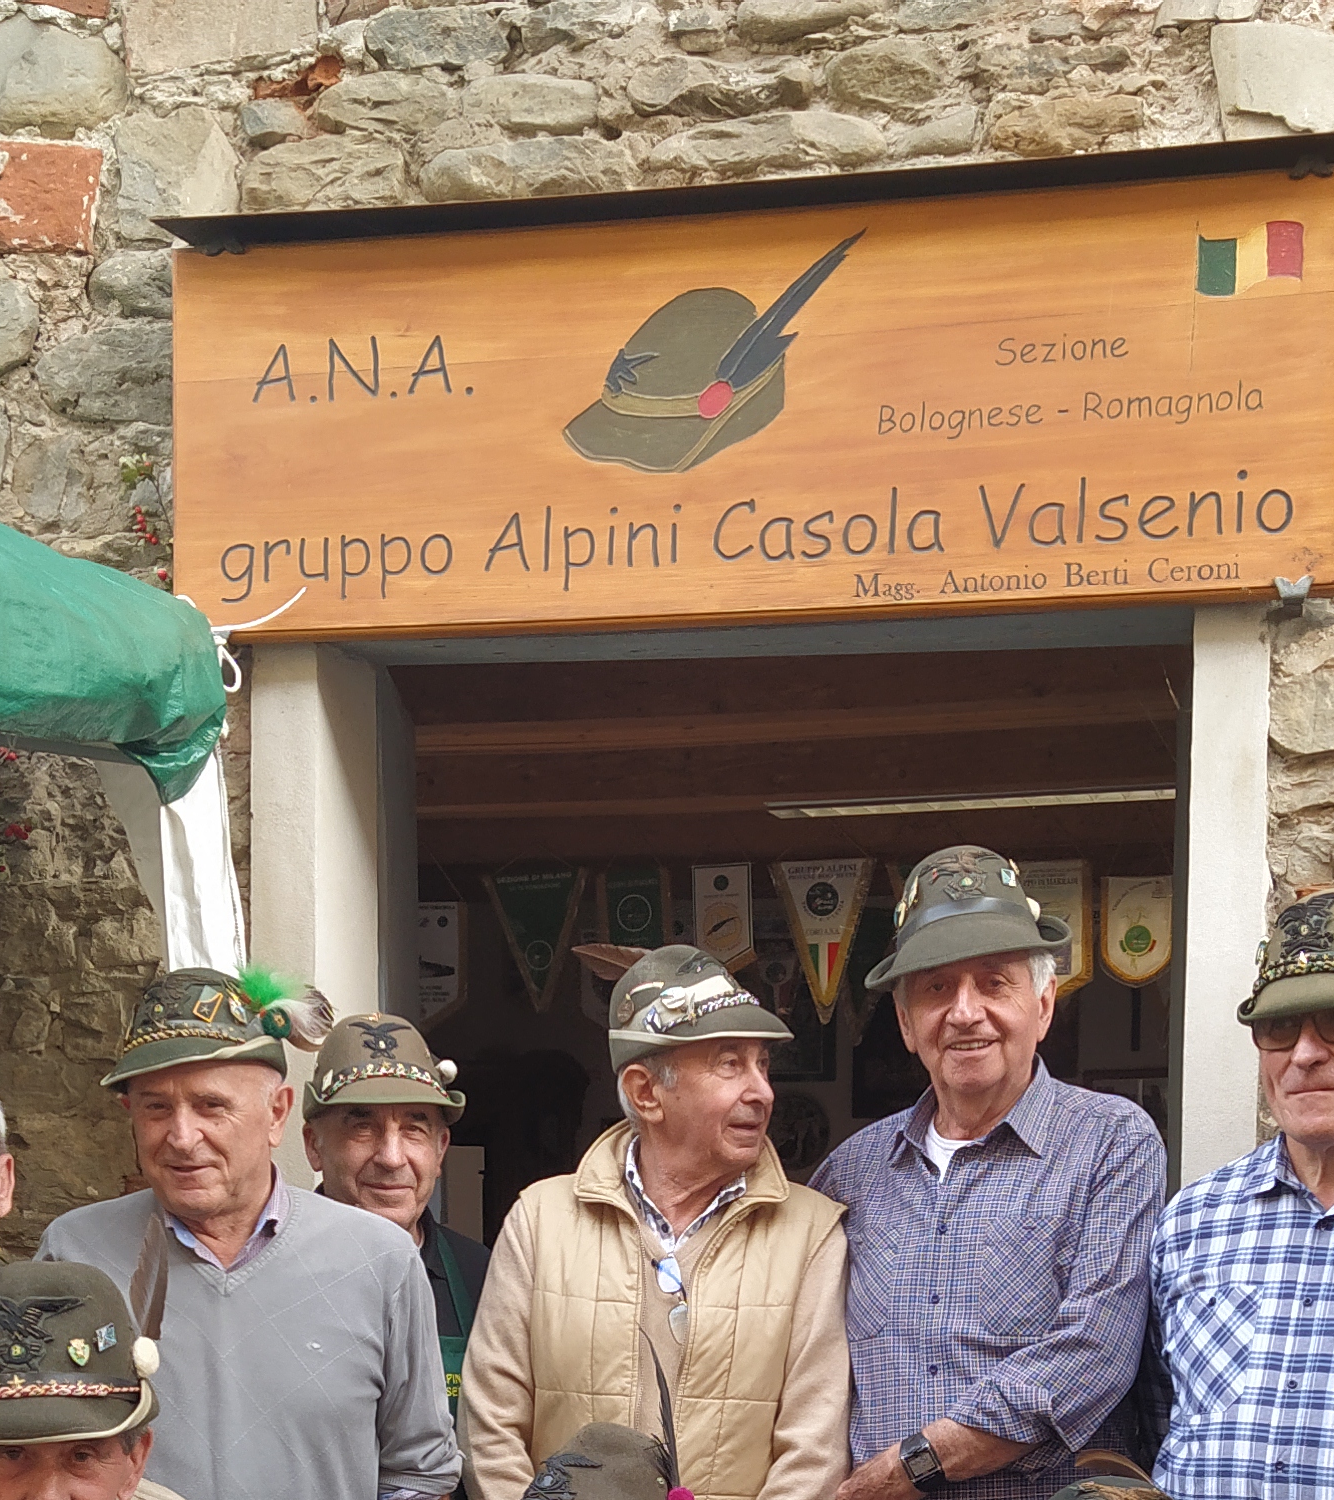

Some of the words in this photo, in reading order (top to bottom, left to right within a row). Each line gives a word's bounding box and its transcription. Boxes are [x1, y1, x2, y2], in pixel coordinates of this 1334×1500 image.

[252, 334, 475, 404] A.N.A.
[993, 333, 1131, 368] Sezione
[876, 400, 1044, 441] Bolognese
[1081, 379, 1266, 426] Romagnola
[219, 532, 455, 604] gruppo
[484, 502, 684, 592] Alpini
[711, 485, 947, 563] Casola
[977, 469, 1295, 551] Valsenio
[852, 571, 922, 603] Magg.
[937, 564, 1049, 597] Antonio
[1063, 558, 1131, 590] Berti
[1147, 553, 1243, 585] Ceroni
